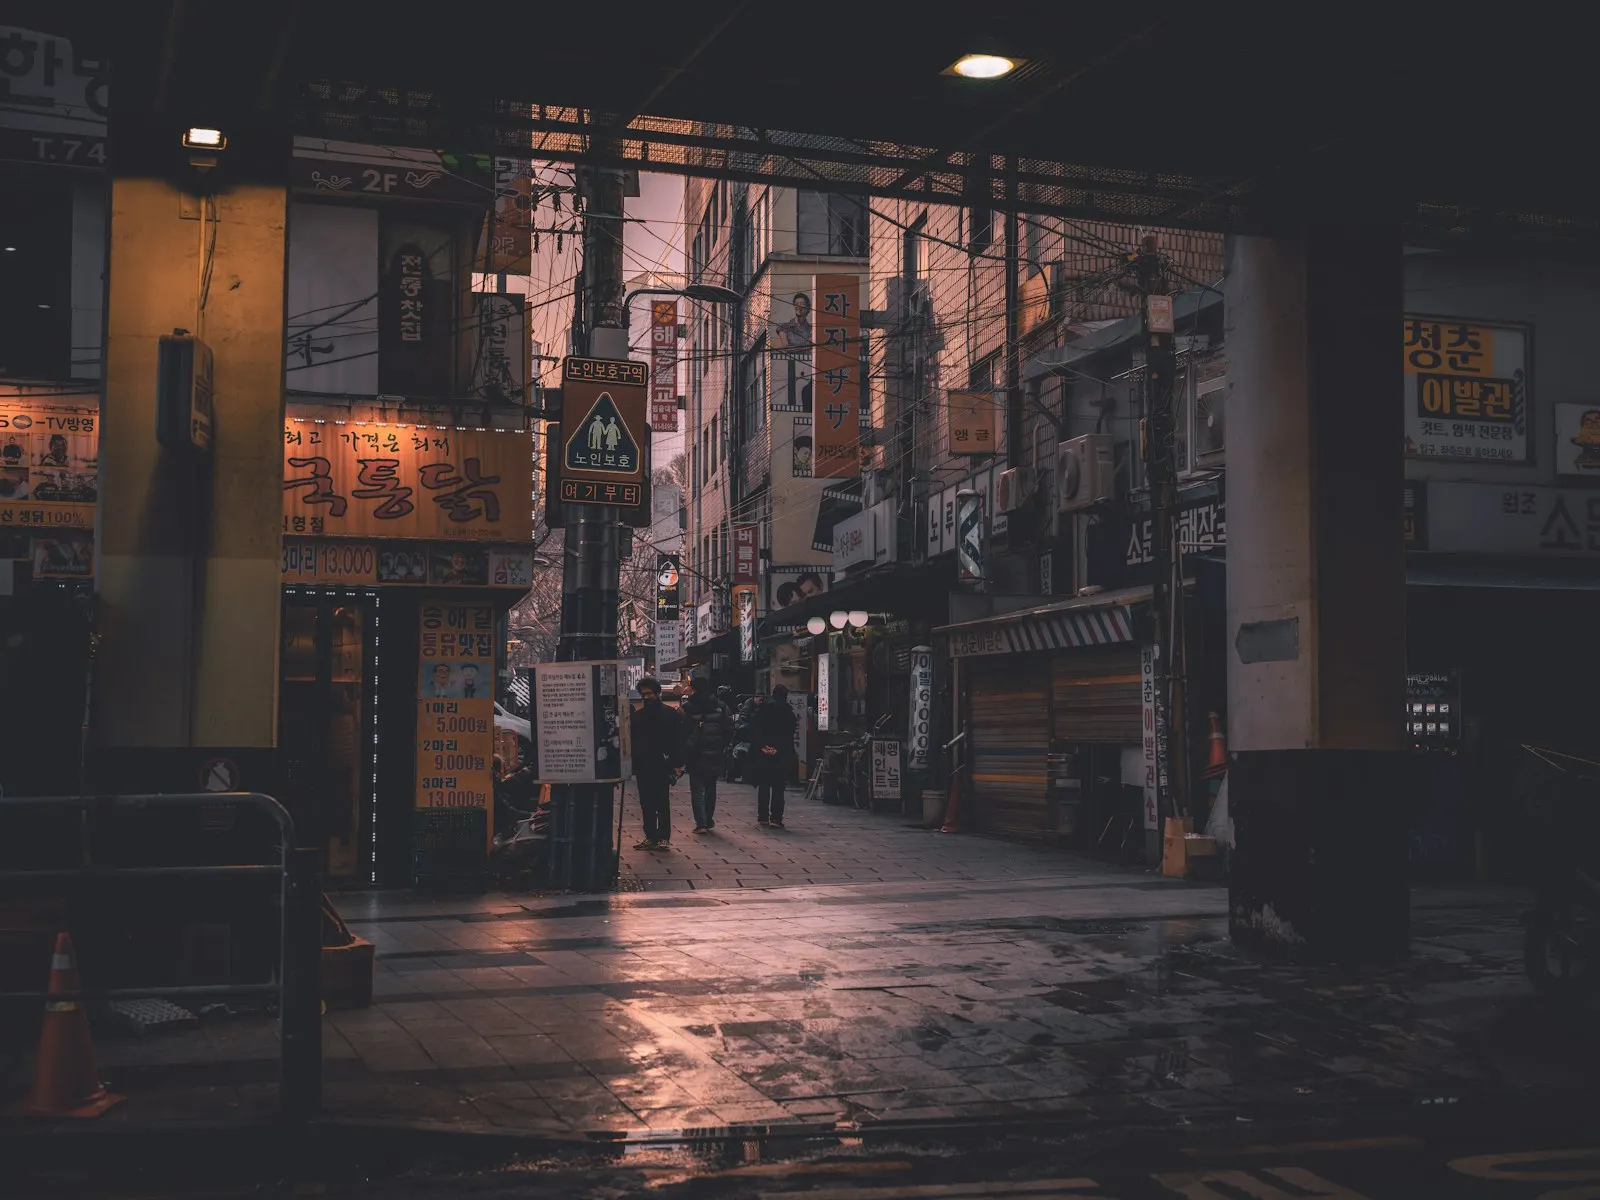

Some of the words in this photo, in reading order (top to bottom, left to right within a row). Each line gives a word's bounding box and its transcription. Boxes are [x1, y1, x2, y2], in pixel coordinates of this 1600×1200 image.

[362, 169, 398, 193] 2F
[1404, 320, 1482, 373] 청춘
[570, 362, 643, 382] 노인보호구역
[1422, 378, 1514, 418] 이발관
[955, 429, 990, 442] 앵글
[1479, 424, 1513, 440] 전문점
[286, 427, 322, 445] 최고
[341, 431, 400, 453] 가격은
[412, 434, 450, 457] 최저
[573, 452, 631, 469] 노인보호
[1502, 492, 1537, 515] 원조
[322, 544, 374, 578] 13,000
[425, 702, 458, 715] 1마리
[437, 717, 488, 734] 5,000원
[423, 739, 457, 752] 2마리
[1145, 708, 1156, 790] 이발관
[434, 755, 486, 772] 9,000원
[422, 777, 457, 790] 3마리
[427, 791, 487, 807] 13,000원
